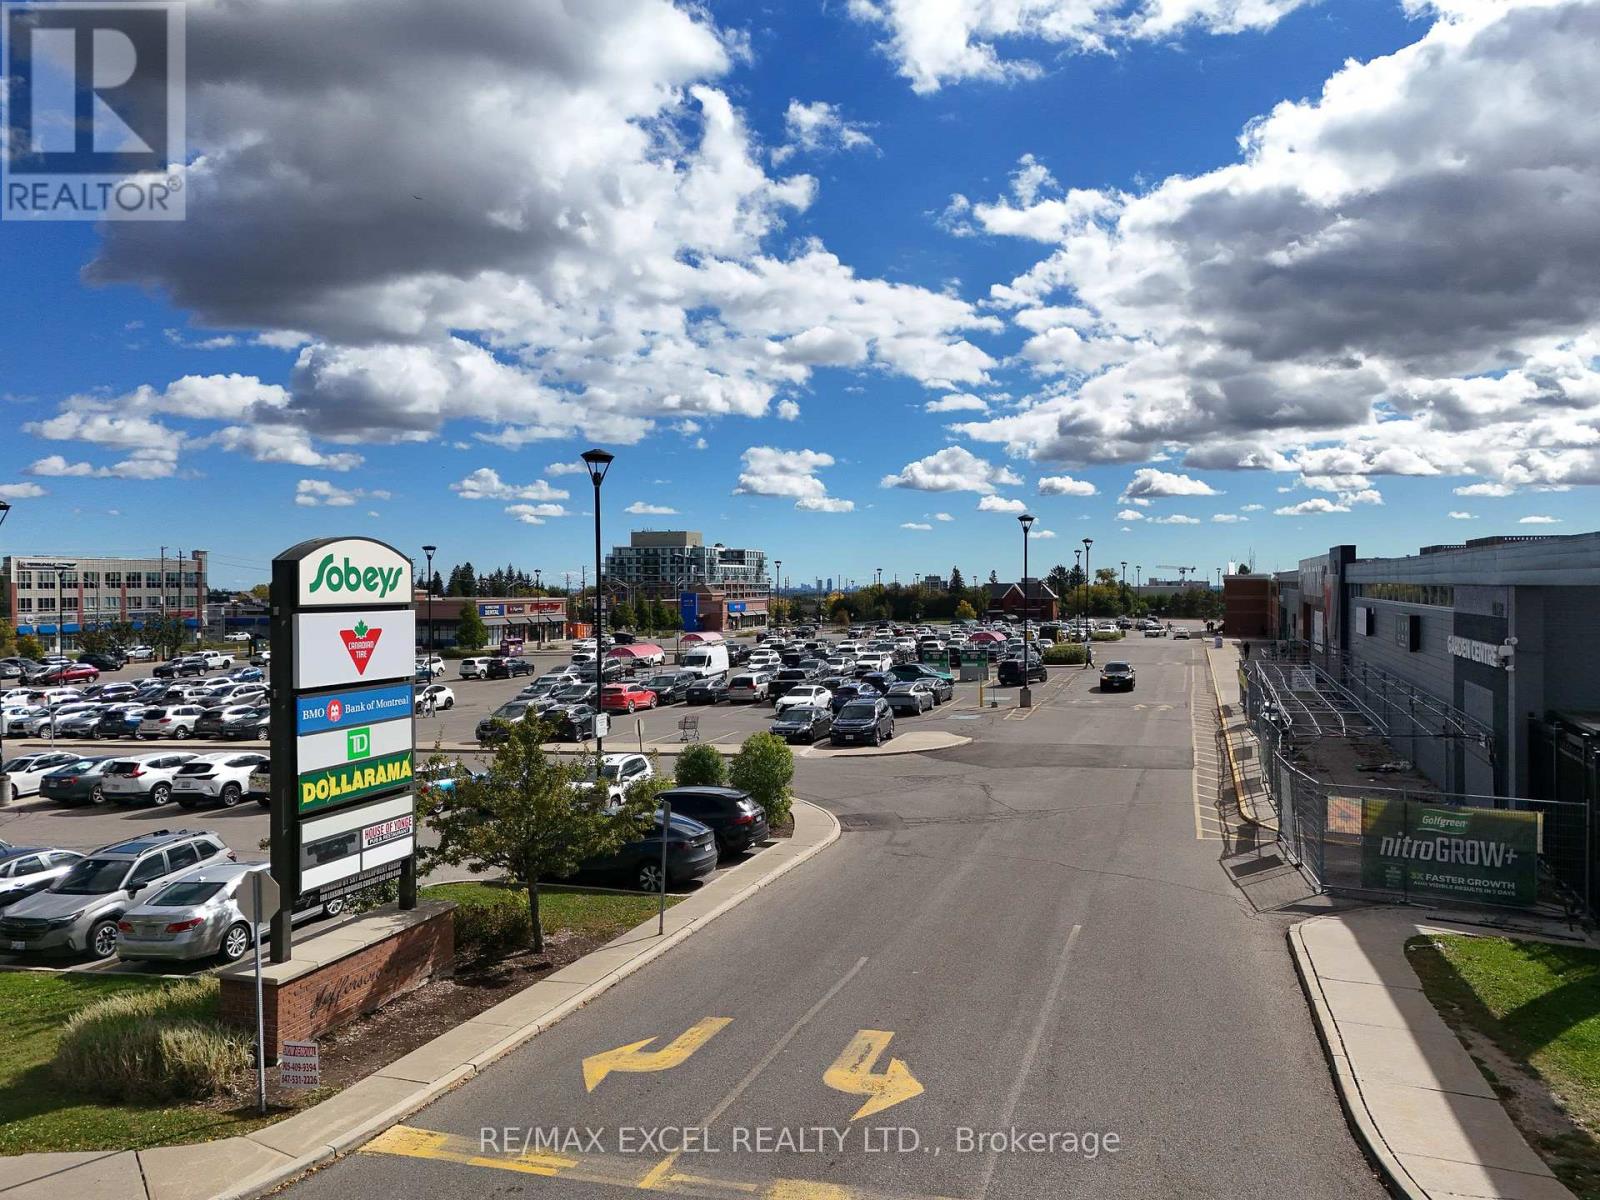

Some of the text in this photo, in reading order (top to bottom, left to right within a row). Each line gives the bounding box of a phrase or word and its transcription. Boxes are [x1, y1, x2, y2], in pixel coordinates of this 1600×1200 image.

[309, 553, 403, 598] Sobeys
[349, 641, 375, 650] CANADIAN
[356, 650, 368, 659] TIRE
[302, 695, 409, 720] BMO Bank of Montreal
[349, 733, 369, 753] TD
[302, 755, 412, 803] DOLLARAMA
[364, 816, 412, 840] HOUSE OF YONGE
[1422, 815, 1466, 828] Golfgreen
[1379, 831, 1518, 868] nitroGROW+
[1425, 873, 1465, 885] FASTER
[1467, 878, 1516, 890] GROWTH
